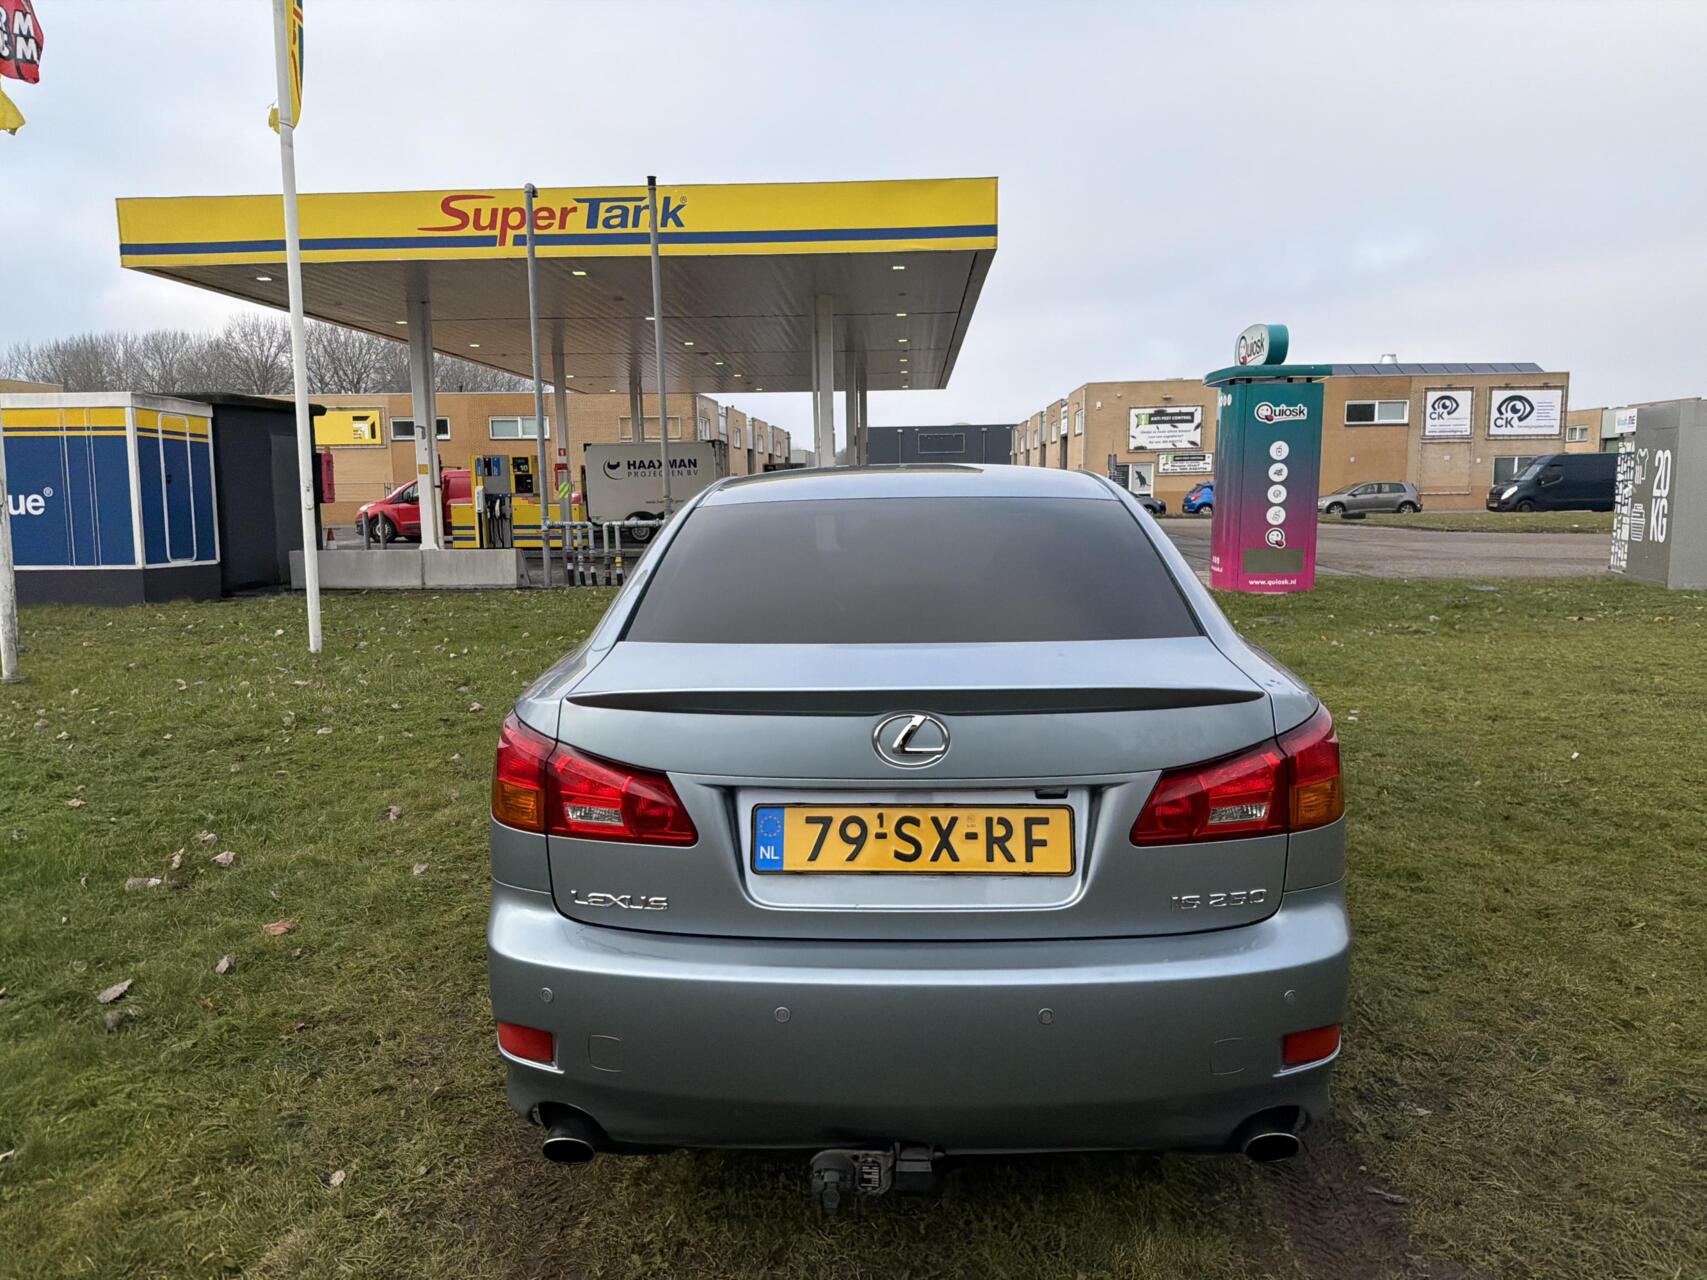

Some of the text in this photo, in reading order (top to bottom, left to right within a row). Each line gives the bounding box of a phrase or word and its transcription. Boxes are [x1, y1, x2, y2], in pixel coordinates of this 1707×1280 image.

[417, 194, 687, 246] SuperTank
[1238, 332, 1265, 365] Quiosk
[1256, 404, 1306, 422] Quiosk
[1429, 411, 1445, 420] CK
[1493, 416, 1514, 428] CK
[627, 469, 683, 478] PROJECEN
[1652, 449, 1671, 498] 20
[1649, 497, 1668, 543] KG
[759, 845, 779, 860] NL
[805, 815, 1050, 863] 79-SX-RF
[571, 890, 668, 910] LEXUS
[1171, 889, 1267, 911] IS 250
